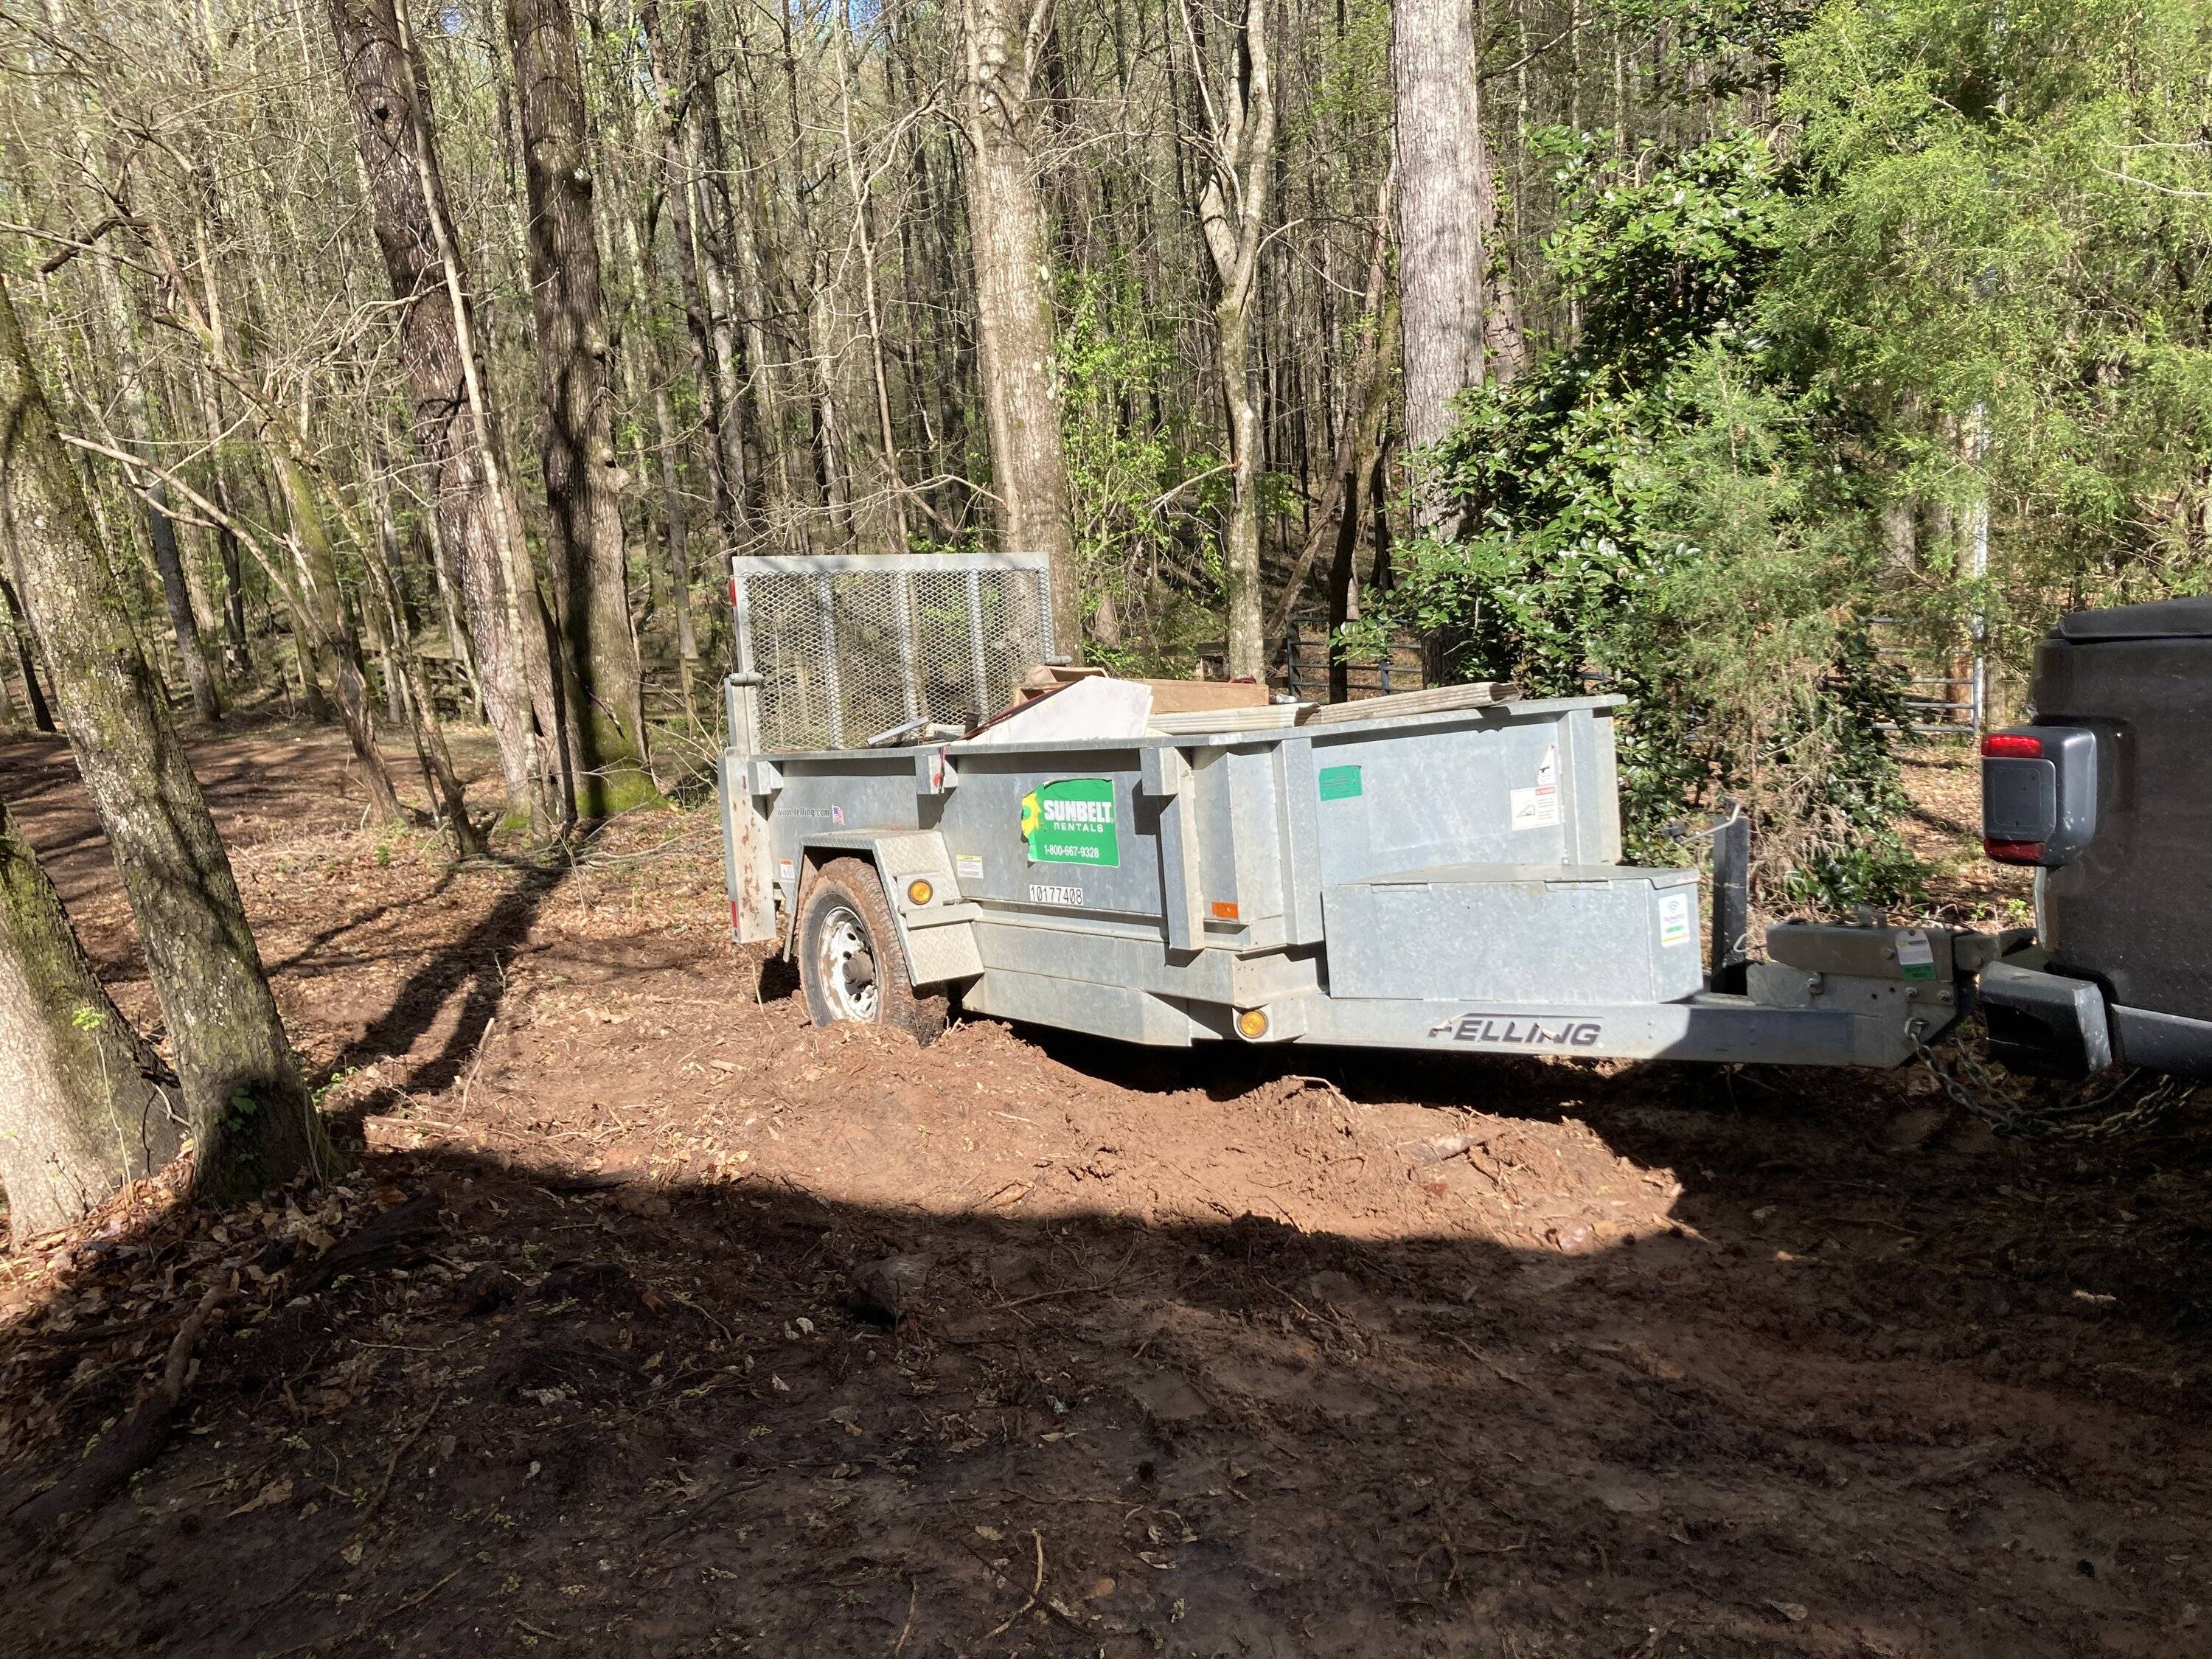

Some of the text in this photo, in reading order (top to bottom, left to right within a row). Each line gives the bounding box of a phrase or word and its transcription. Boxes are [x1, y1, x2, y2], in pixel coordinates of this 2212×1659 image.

[1043, 800, 1112, 823] SUNBELT
[1054, 822, 1104, 832] RENTALS
[1043, 844, 1099, 858] 1-800-667-9328
[1030, 886, 1082, 905] 10177408
